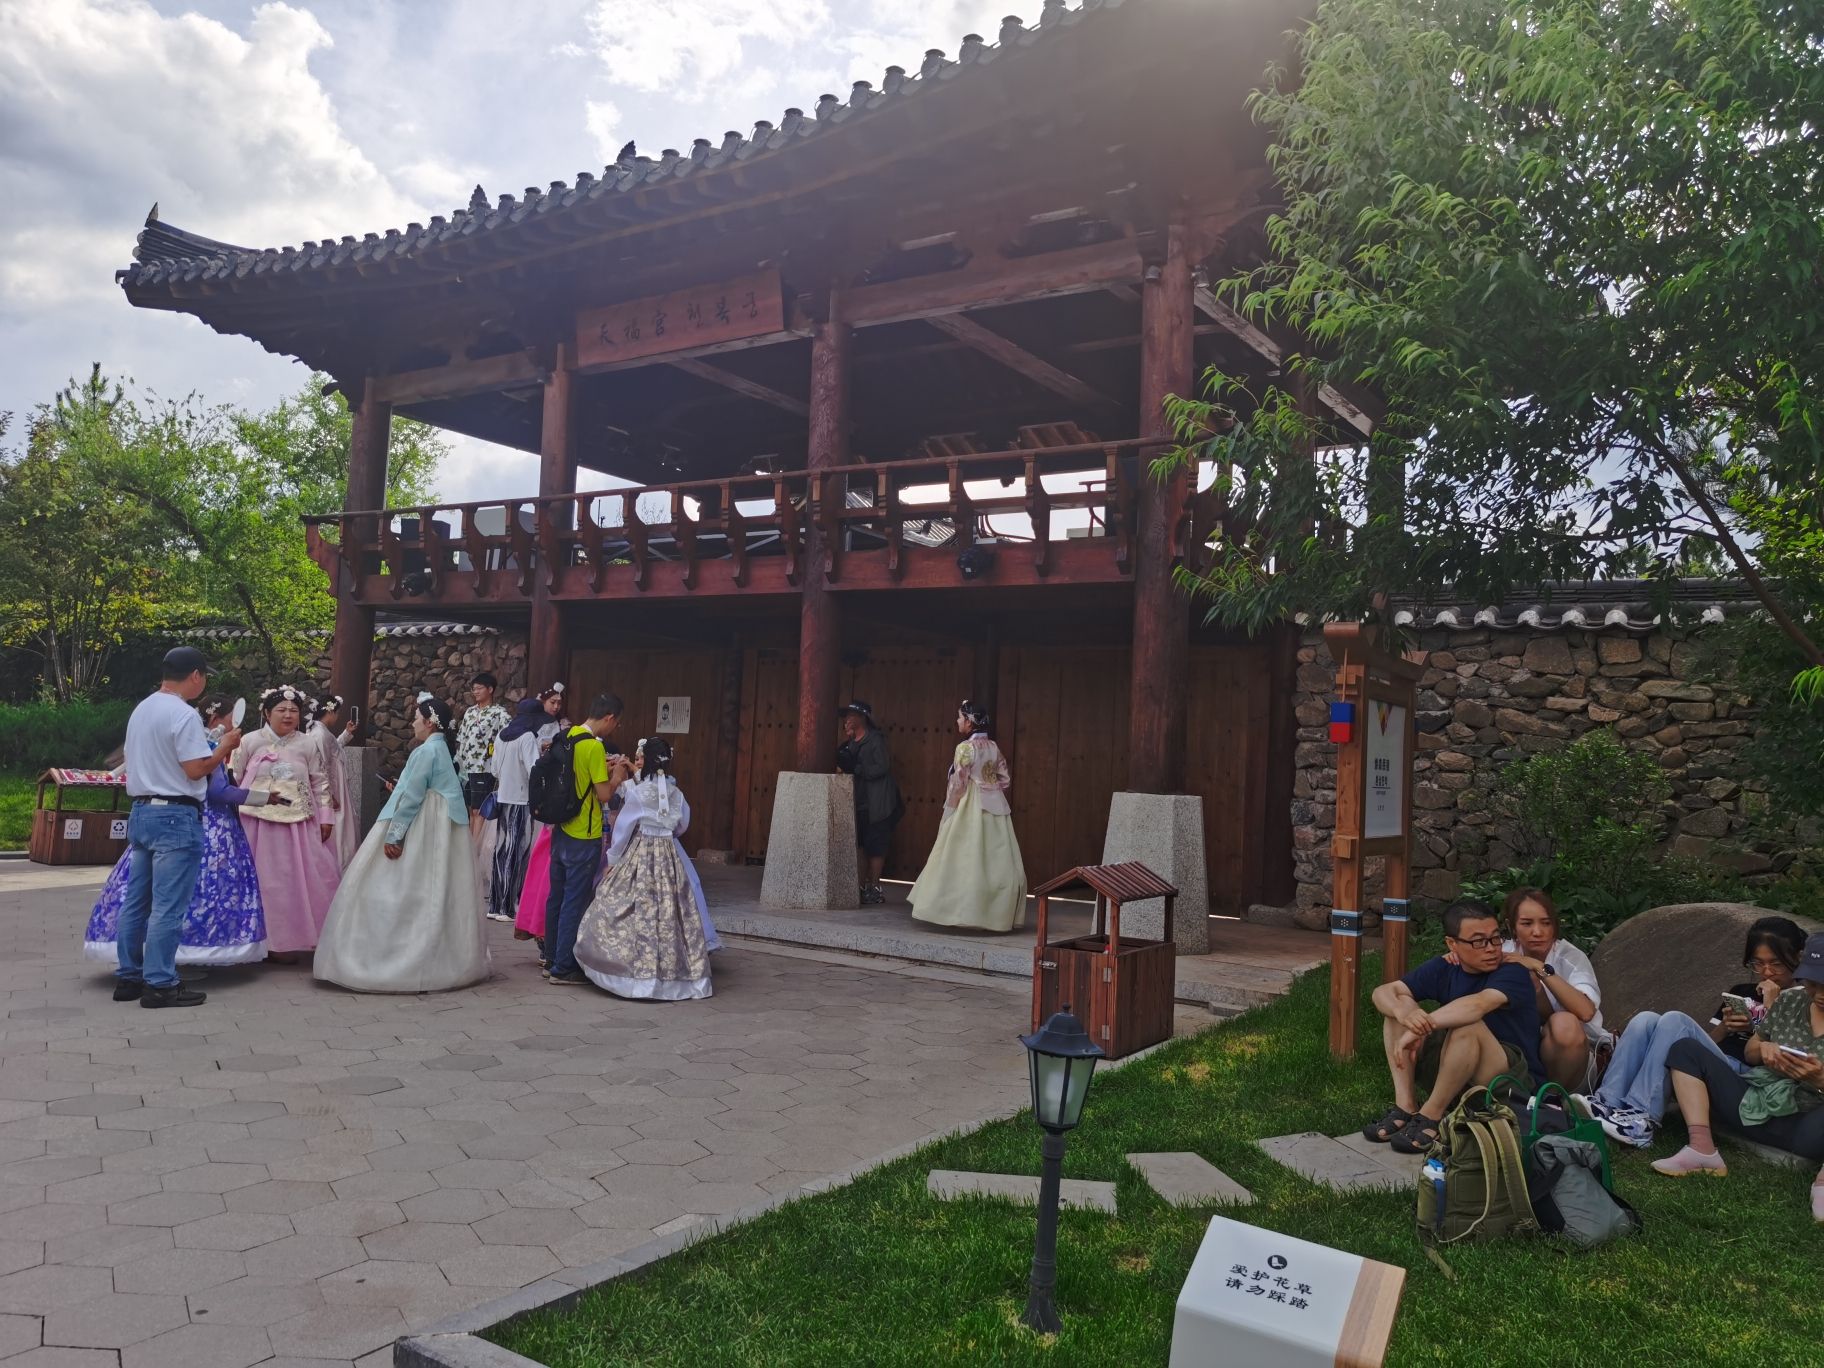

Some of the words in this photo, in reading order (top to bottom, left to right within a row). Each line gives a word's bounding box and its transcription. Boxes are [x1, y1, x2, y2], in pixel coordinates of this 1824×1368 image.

[1225, 1277, 1310, 1310] 请勿踩踏
[1229, 1264, 1313, 1295] 爱护花草
